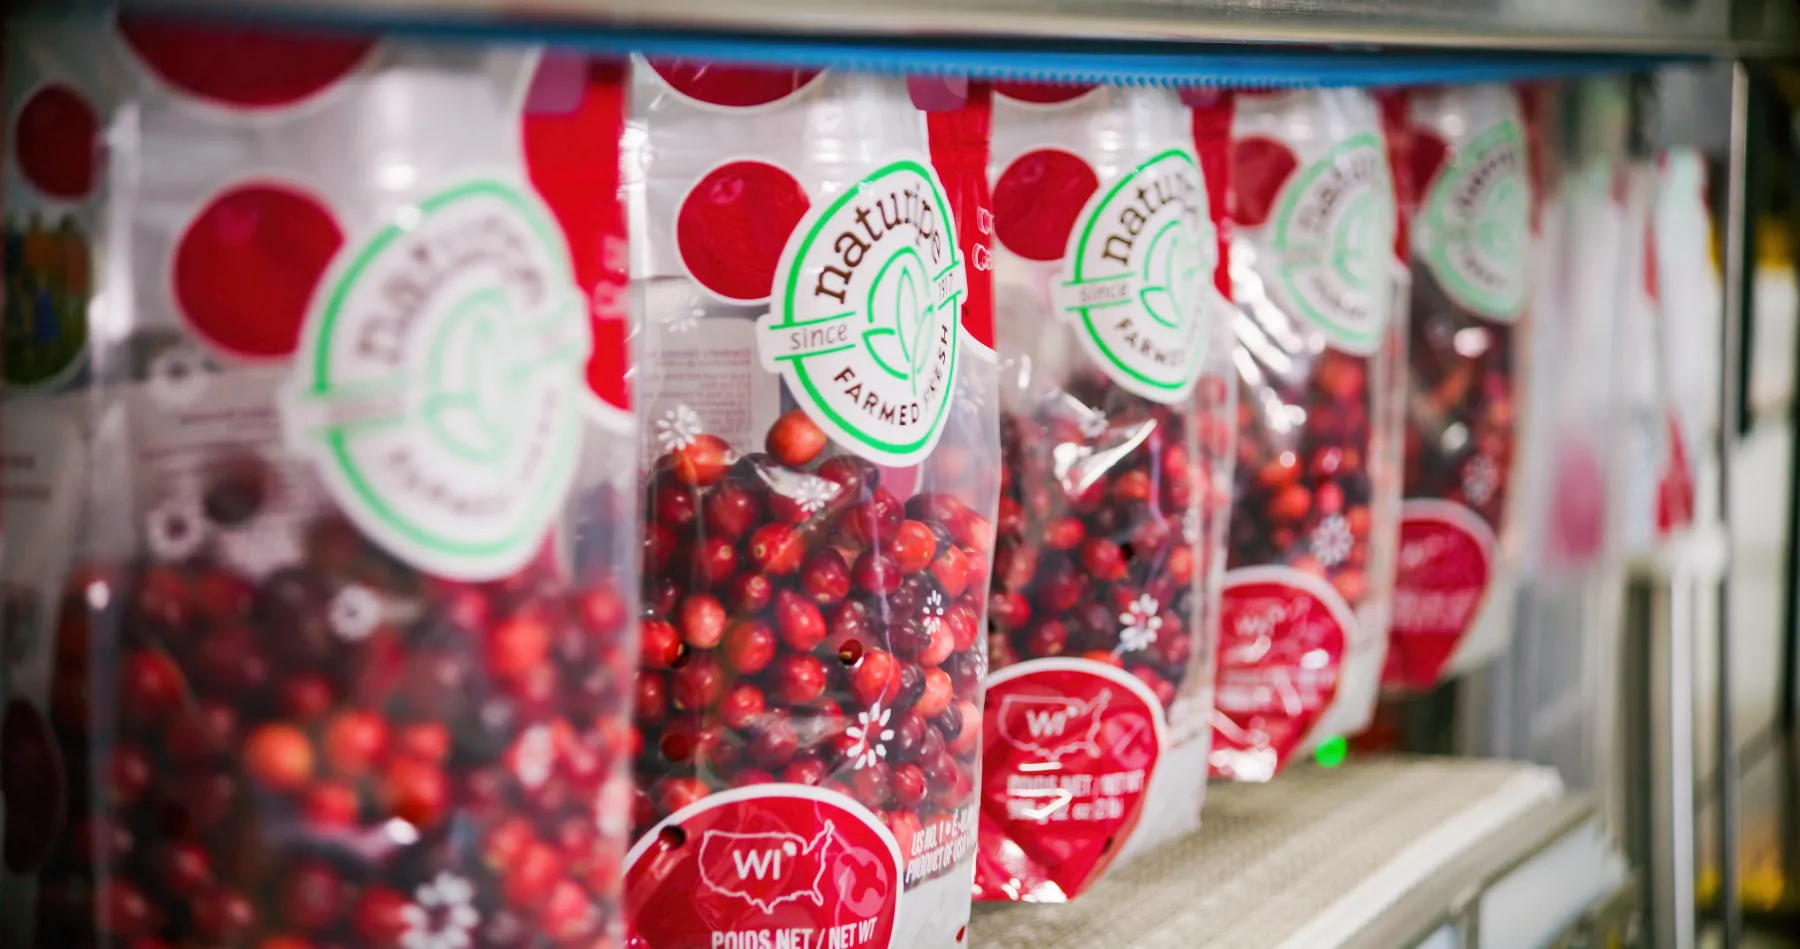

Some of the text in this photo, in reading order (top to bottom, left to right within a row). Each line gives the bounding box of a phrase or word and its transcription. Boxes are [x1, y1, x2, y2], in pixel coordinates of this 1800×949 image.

[814, 182, 940, 305] naturipe
[790, 323, 848, 350] since
[833, 366, 919, 426] FARMED
[732, 849, 782, 881] WI
[712, 916, 878, 949] POIDS NET / NET WT
